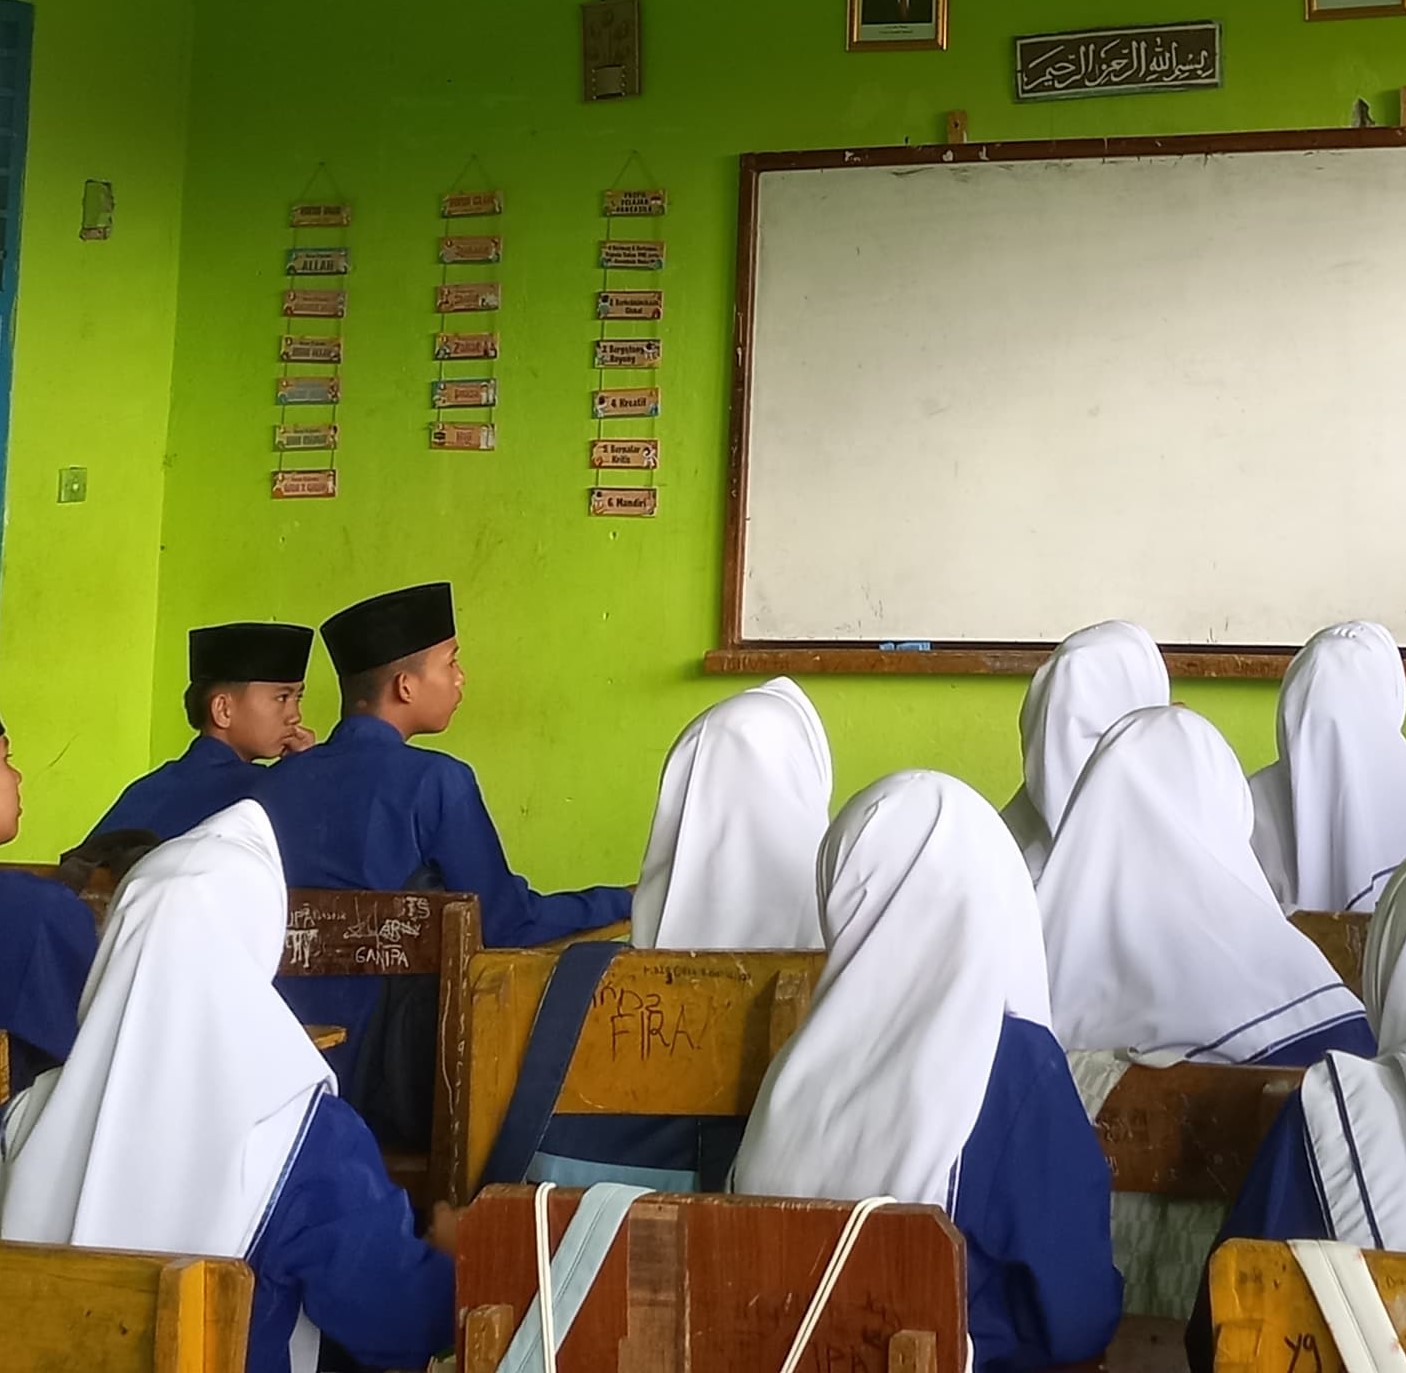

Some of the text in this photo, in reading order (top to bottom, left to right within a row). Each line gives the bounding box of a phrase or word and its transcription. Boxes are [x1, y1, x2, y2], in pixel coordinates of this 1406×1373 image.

[302, 260, 334, 270] ALLAH
[619, 397, 647, 408] Kreatif
[616, 497, 647, 508] Mandiri
